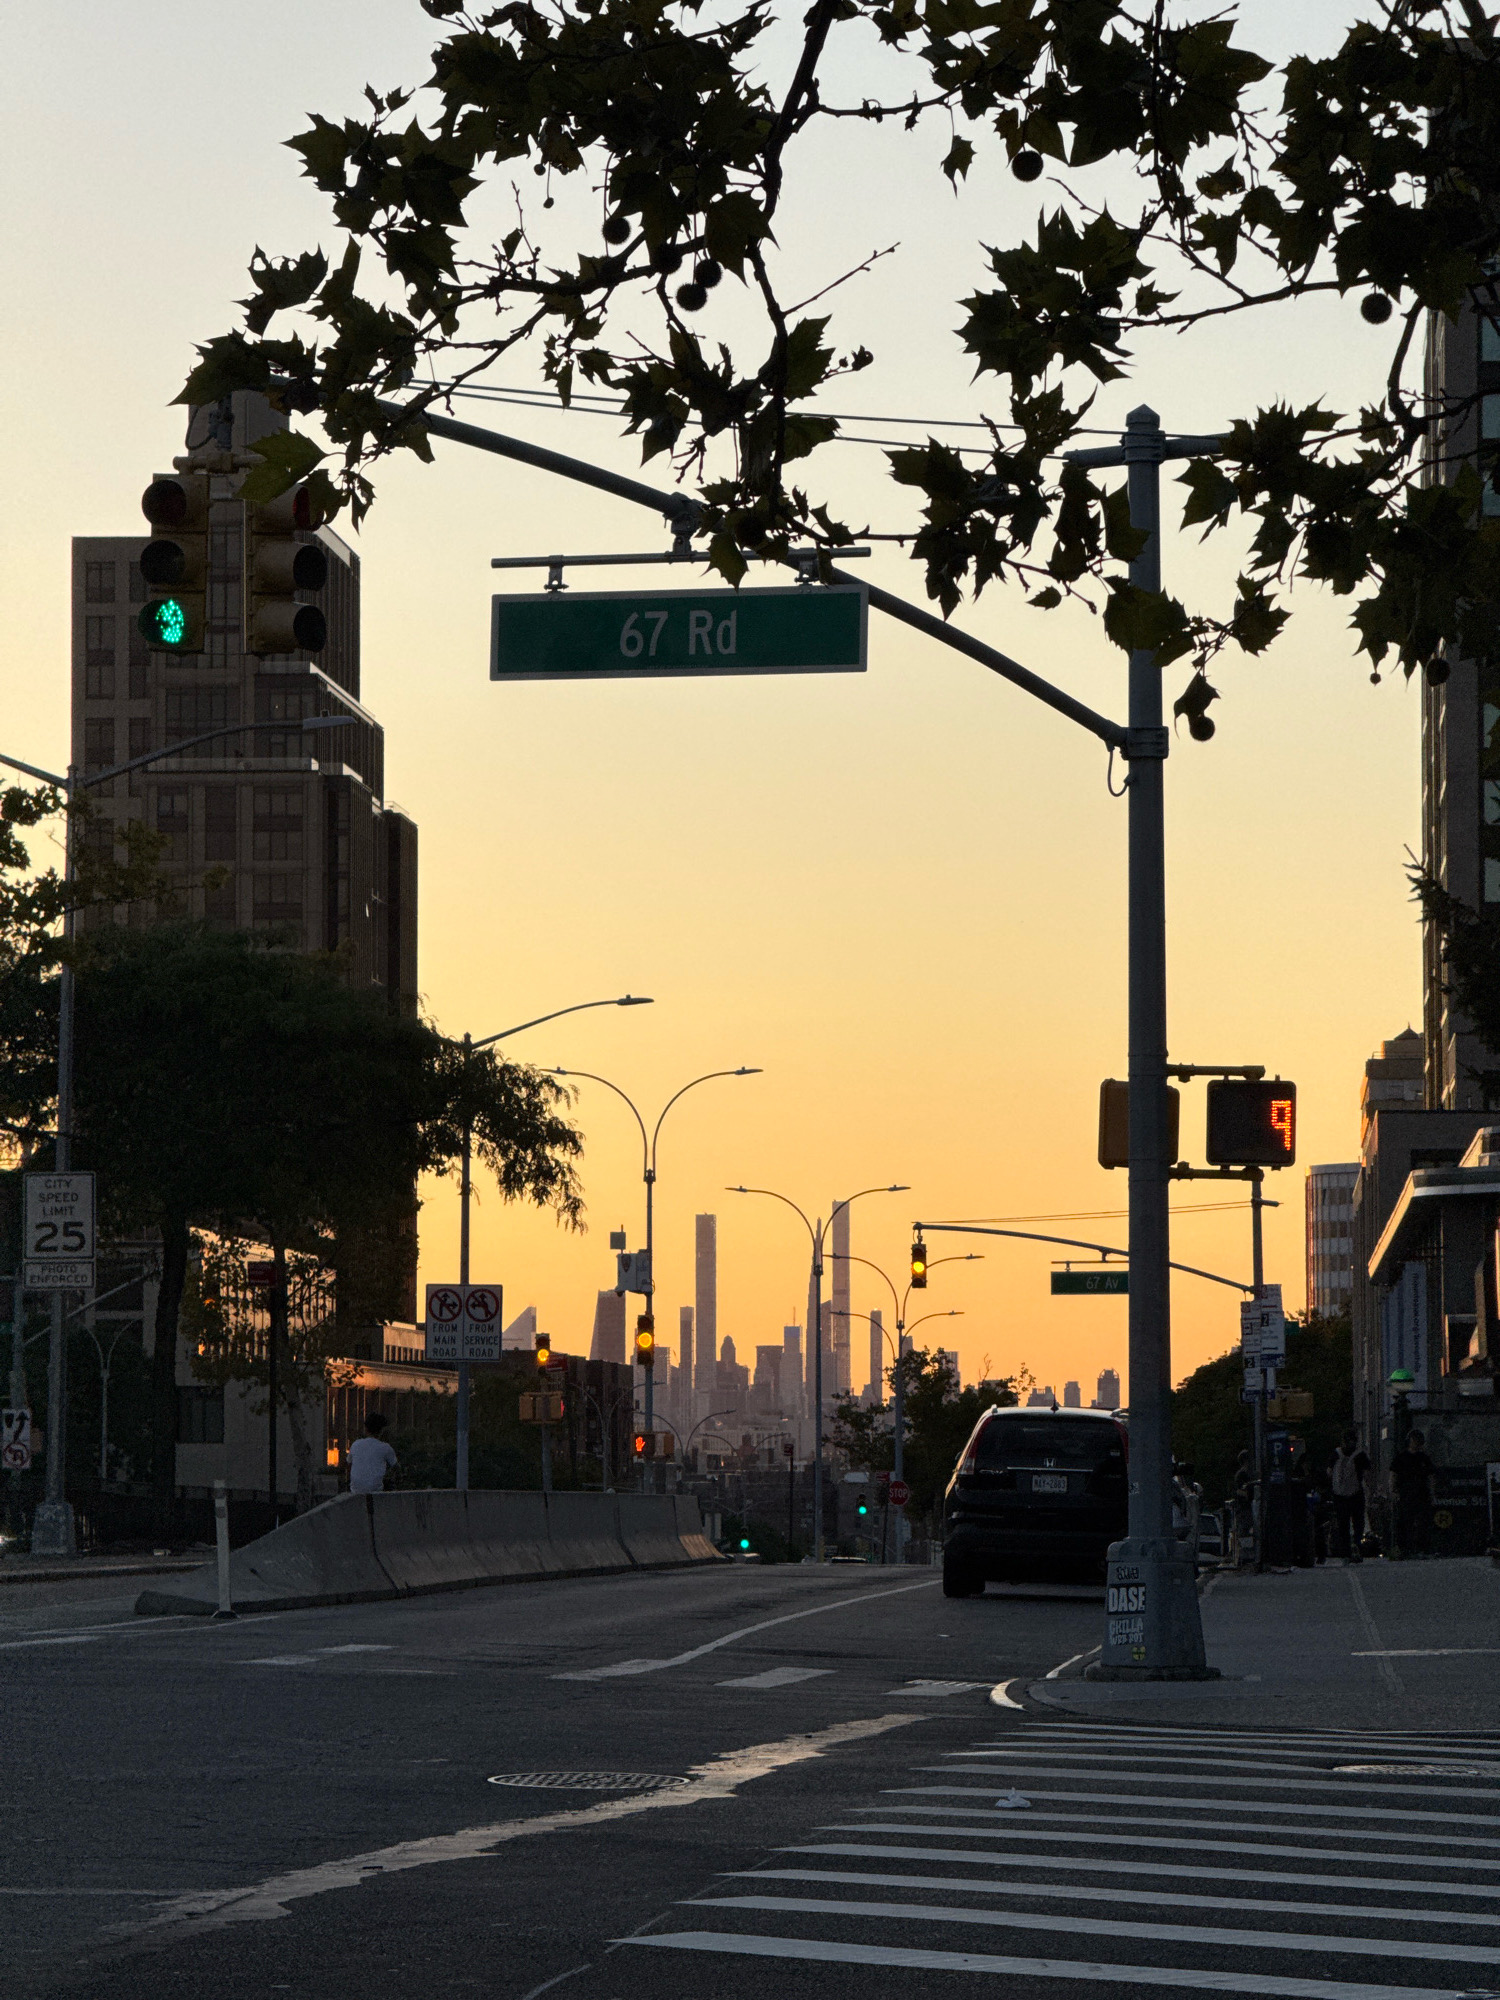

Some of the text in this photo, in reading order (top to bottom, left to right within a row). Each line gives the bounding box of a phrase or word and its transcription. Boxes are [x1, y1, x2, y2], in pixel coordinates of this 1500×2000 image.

[618, 608, 738, 658] 67 Rd
[1270, 1099, 1292, 1151] 9
[44, 1178, 73, 1189] CITY
[39, 1192, 79, 1203] SPEED
[42, 1205, 75, 1216] LIMIT
[34, 1221, 86, 1253] 25
[41, 1264, 77, 1274] PHOTO
[30, 1275, 88, 1283] ENFORCED
[1086, 1276, 1119, 1290] 67 Av
[432, 1323, 458, 1333] FROM
[469, 1323, 494, 1333] FROM
[434, 1335, 456, 1345] MAIN
[464, 1335, 498, 1345] SERVICE
[432, 1347, 457, 1357] ROAD
[469, 1347, 494, 1358] ROAD
[889, 1487, 908, 1499] STOP
[1108, 1586, 1146, 1613] DASE
